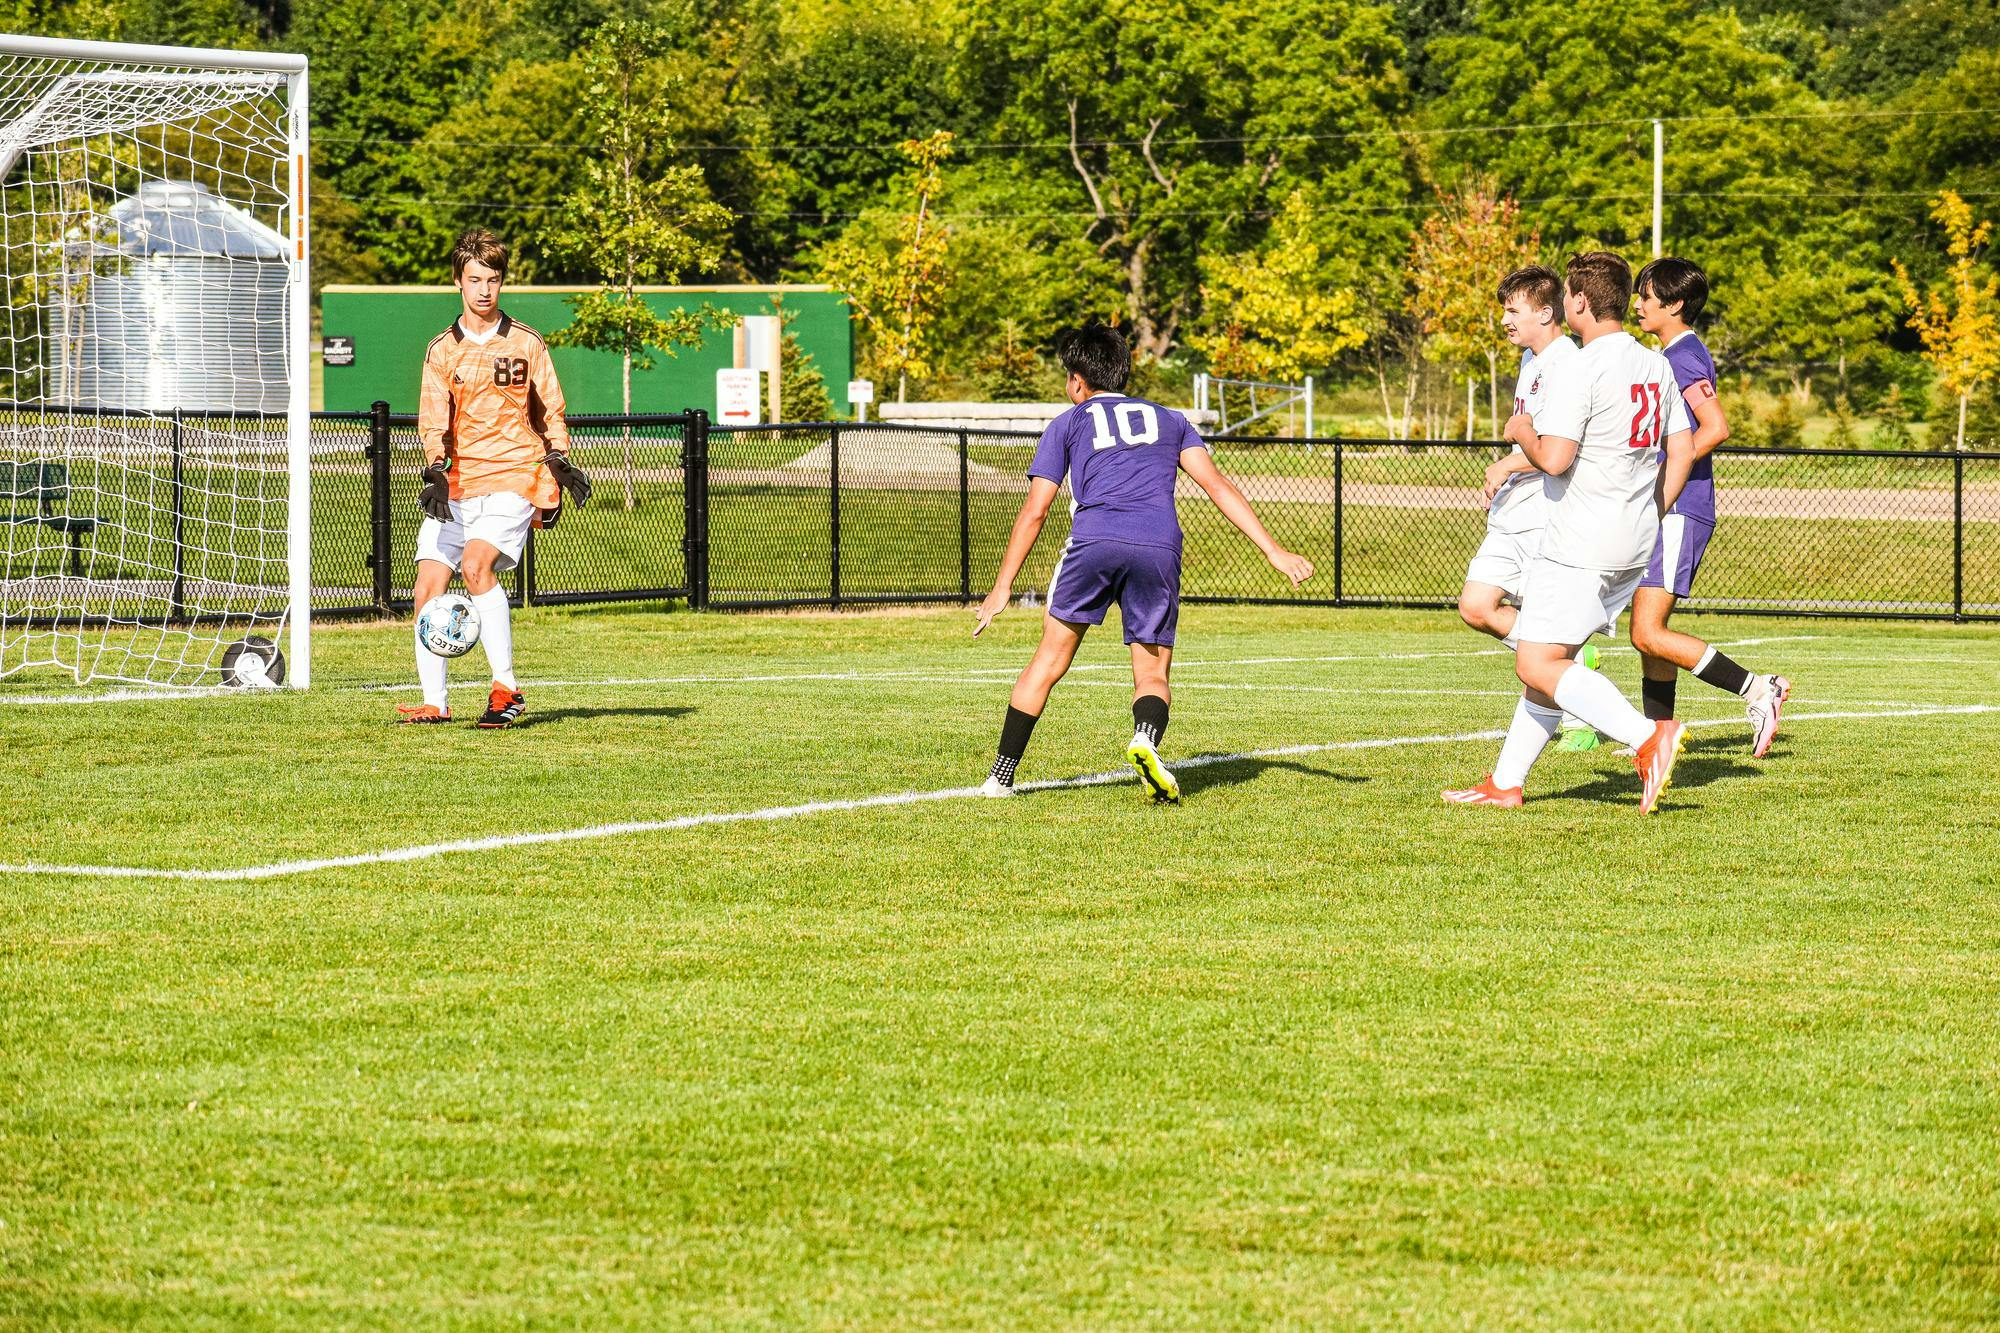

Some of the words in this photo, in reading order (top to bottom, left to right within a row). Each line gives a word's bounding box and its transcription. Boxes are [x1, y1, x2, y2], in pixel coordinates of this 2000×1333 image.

[1700, 383, 1713, 398] C
[1085, 402, 1159, 450] 10
[1629, 383, 1661, 447] 21
[430, 634, 464, 654] SELECT
